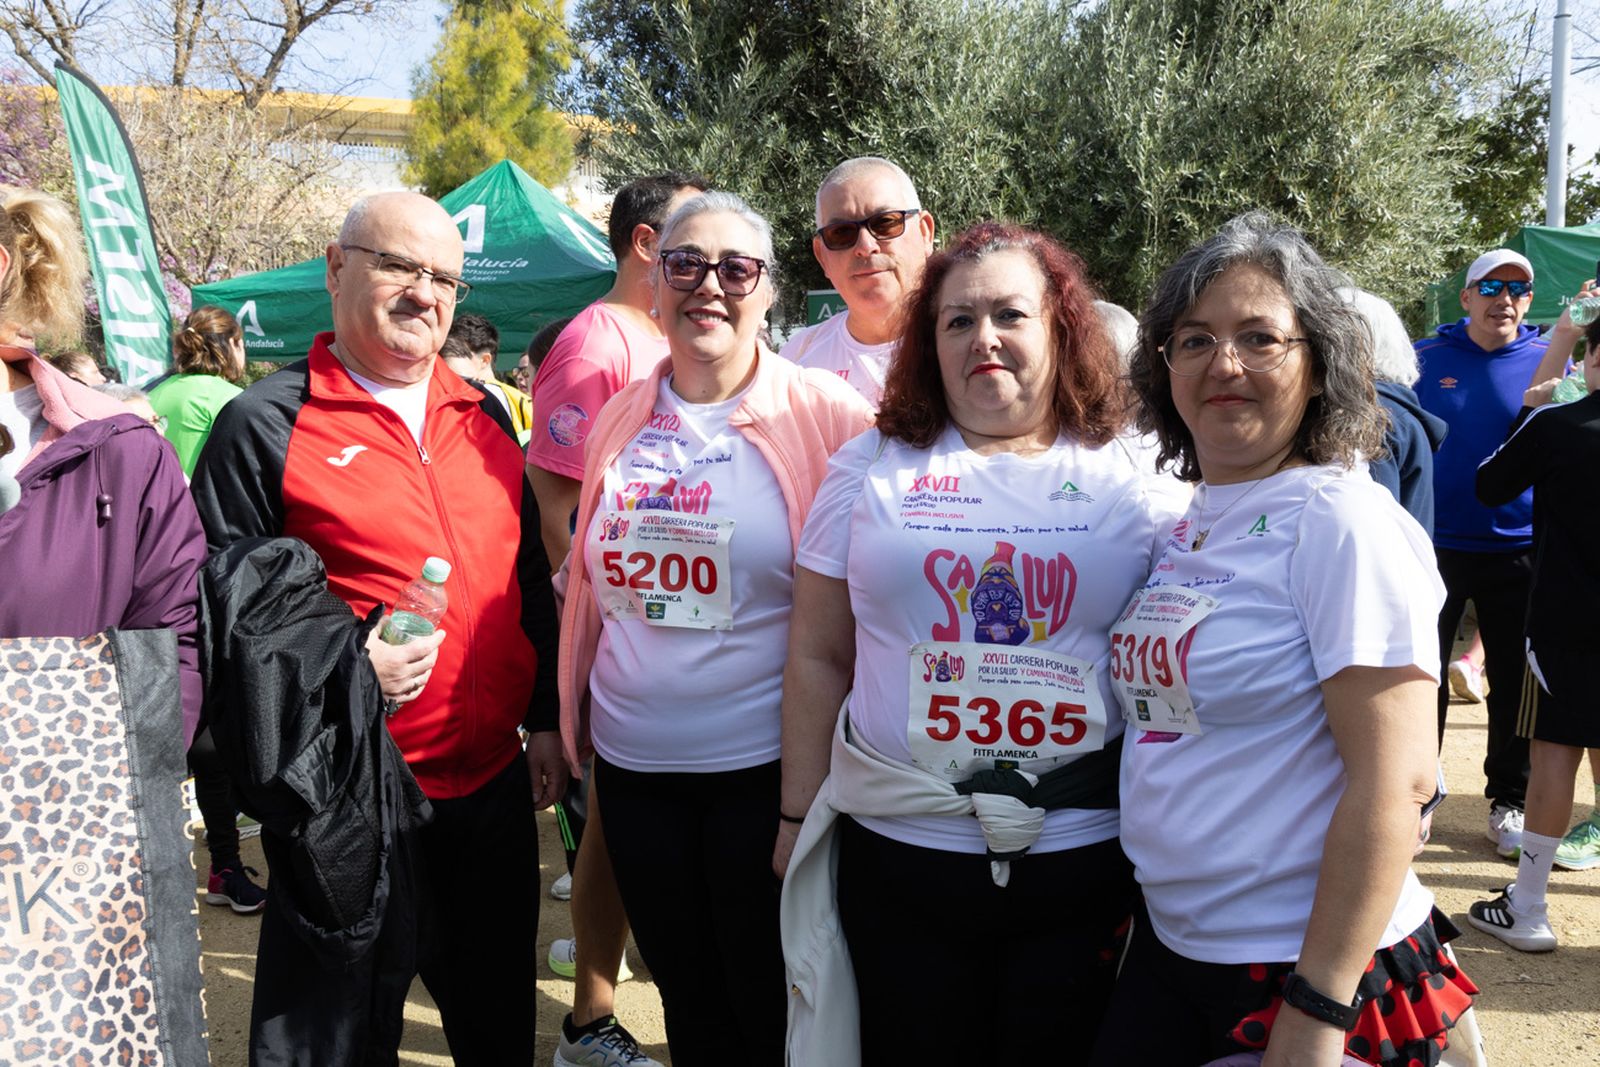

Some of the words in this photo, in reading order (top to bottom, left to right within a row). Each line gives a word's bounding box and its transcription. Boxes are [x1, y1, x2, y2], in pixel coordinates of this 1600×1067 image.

[245, 338, 284, 348] Andalucía
[908, 472, 961, 493] XXVII
[903, 492, 938, 503] CARRERA
[939, 495, 983, 504] POPULAR
[641, 515, 661, 525] XXVII
[661, 516, 687, 526] CARRERA
[687, 519, 719, 531] POPULAR
[903, 521, 930, 531] Porque
[933, 524, 952, 532] cada
[977, 526, 1010, 534] cuenta,
[1012, 525, 1035, 534] Jaén
[1067, 524, 1089, 532] salud
[602, 551, 718, 595] 5200
[924, 549, 1078, 642] SALUD
[922, 650, 965, 683] SALUD
[982, 653, 1009, 665] XXVII
[1010, 654, 1044, 668] CARRERA
[1045, 659, 1079, 676] POPULAR
[1111, 633, 1174, 688] 5319
[978, 666, 990, 674] POR
[992, 666, 1000, 675] LA
[1000, 667, 1019, 676] SALUD
[1026, 669, 1056, 679] CAMINATA
[925, 694, 1087, 747] 5365
[973, 748, 1038, 759] FITFLAMENCA
